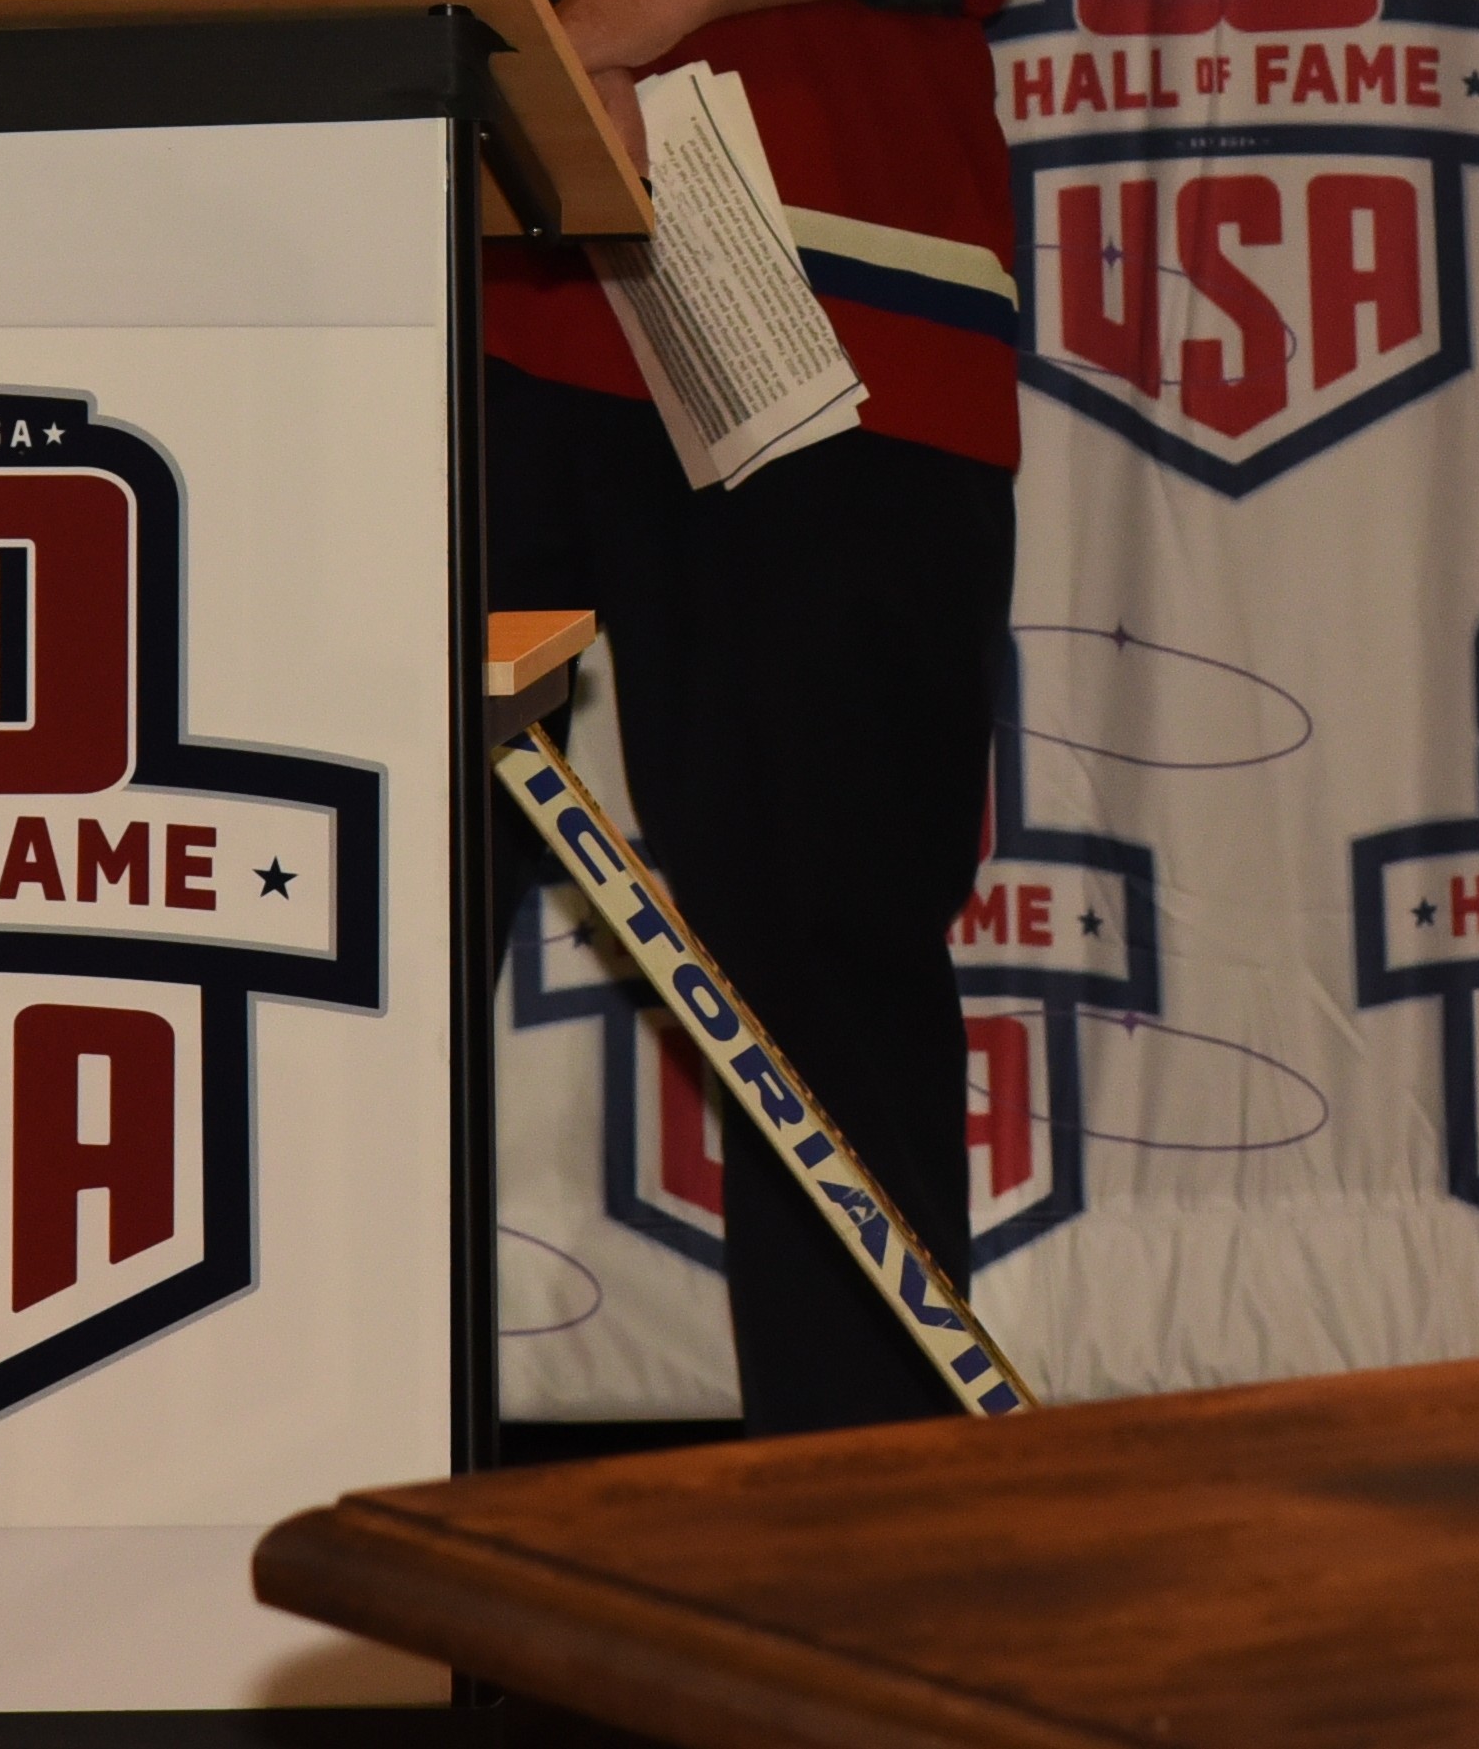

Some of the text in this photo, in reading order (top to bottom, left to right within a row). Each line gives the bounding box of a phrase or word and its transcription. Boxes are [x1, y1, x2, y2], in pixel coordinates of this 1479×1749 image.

[1014, 44, 1440, 119] HALL OF FAME
[1059, 174, 1421, 438] USA
